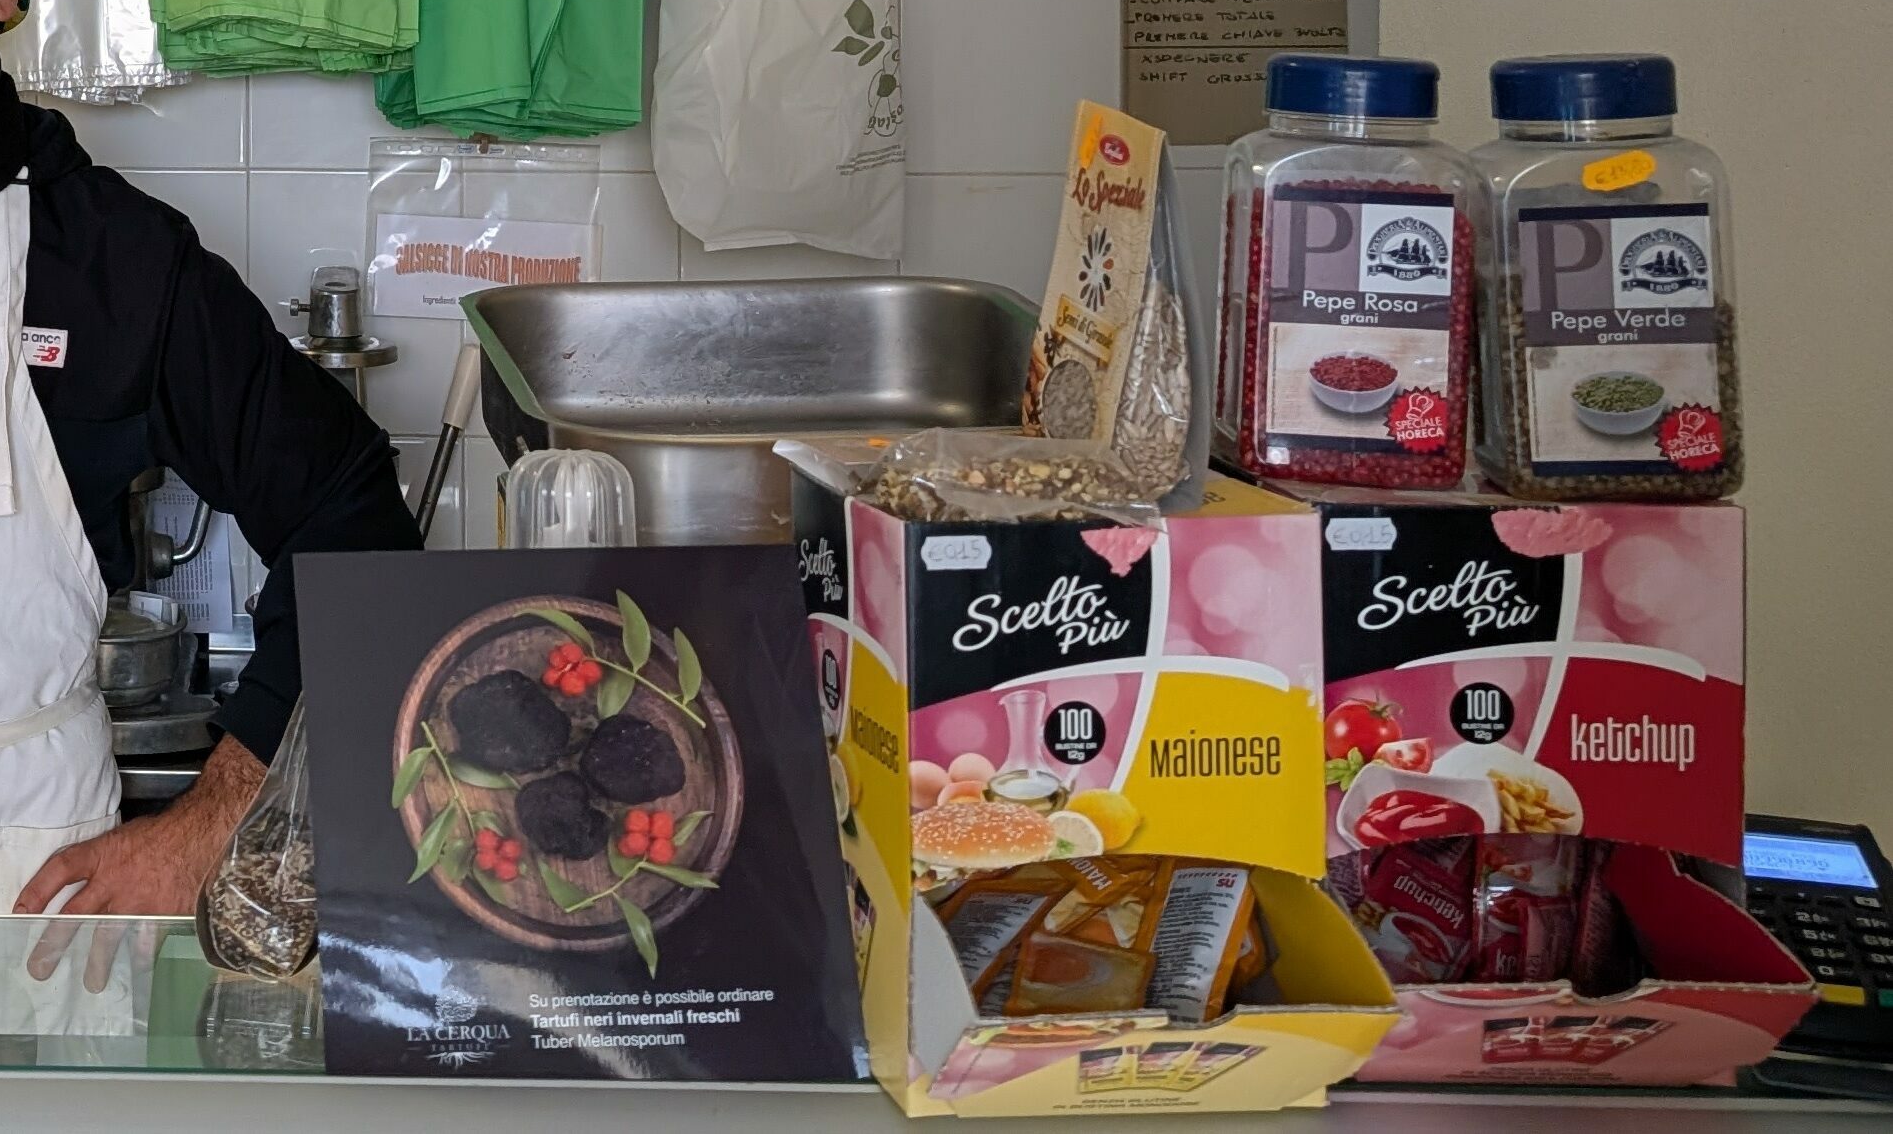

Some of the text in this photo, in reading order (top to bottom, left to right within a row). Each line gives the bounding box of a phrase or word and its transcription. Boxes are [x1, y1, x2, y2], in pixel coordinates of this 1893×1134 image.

[1217, 11, 1275, 21] TOTALE
[1135, 29, 1283, 42] PREMERE CHIAVE
[1139, 72, 1187, 82] SHIFT
[451, 245, 463, 275] DI
[1302, 291, 1418, 313] Pepe Rosa
[1340, 314, 1379, 325] grani
[1551, 309, 1686, 332] Pepe Verde
[1598, 330, 1638, 343] grani
[1395, 416, 1442, 432] SPECIALE
[1396, 426, 1445, 442] HORECA
[1666, 433, 1716, 448] SPECIALE
[1669, 443, 1720, 459] HORECA
[799, 537, 836, 581] Scelto
[1357, 560, 1540, 637] Scelto Più
[952, 575, 1129, 655] Scelto Più
[1465, 689, 1500, 721] 100
[1058, 709, 1092, 740] 100
[1150, 728, 1281, 778] Maionese
[1571, 714, 1695, 772] ketchup
[1393, 874, 1466, 929] ketchup
[530, 988, 774, 1010] Su prenotazione è possibile ordinare
[530, 1008, 740, 1029] Tartufi neri invernali freschi
[407, 1024, 511, 1043] LA CERQUA
[531, 1032, 685, 1051] Tuber Melanosporum
